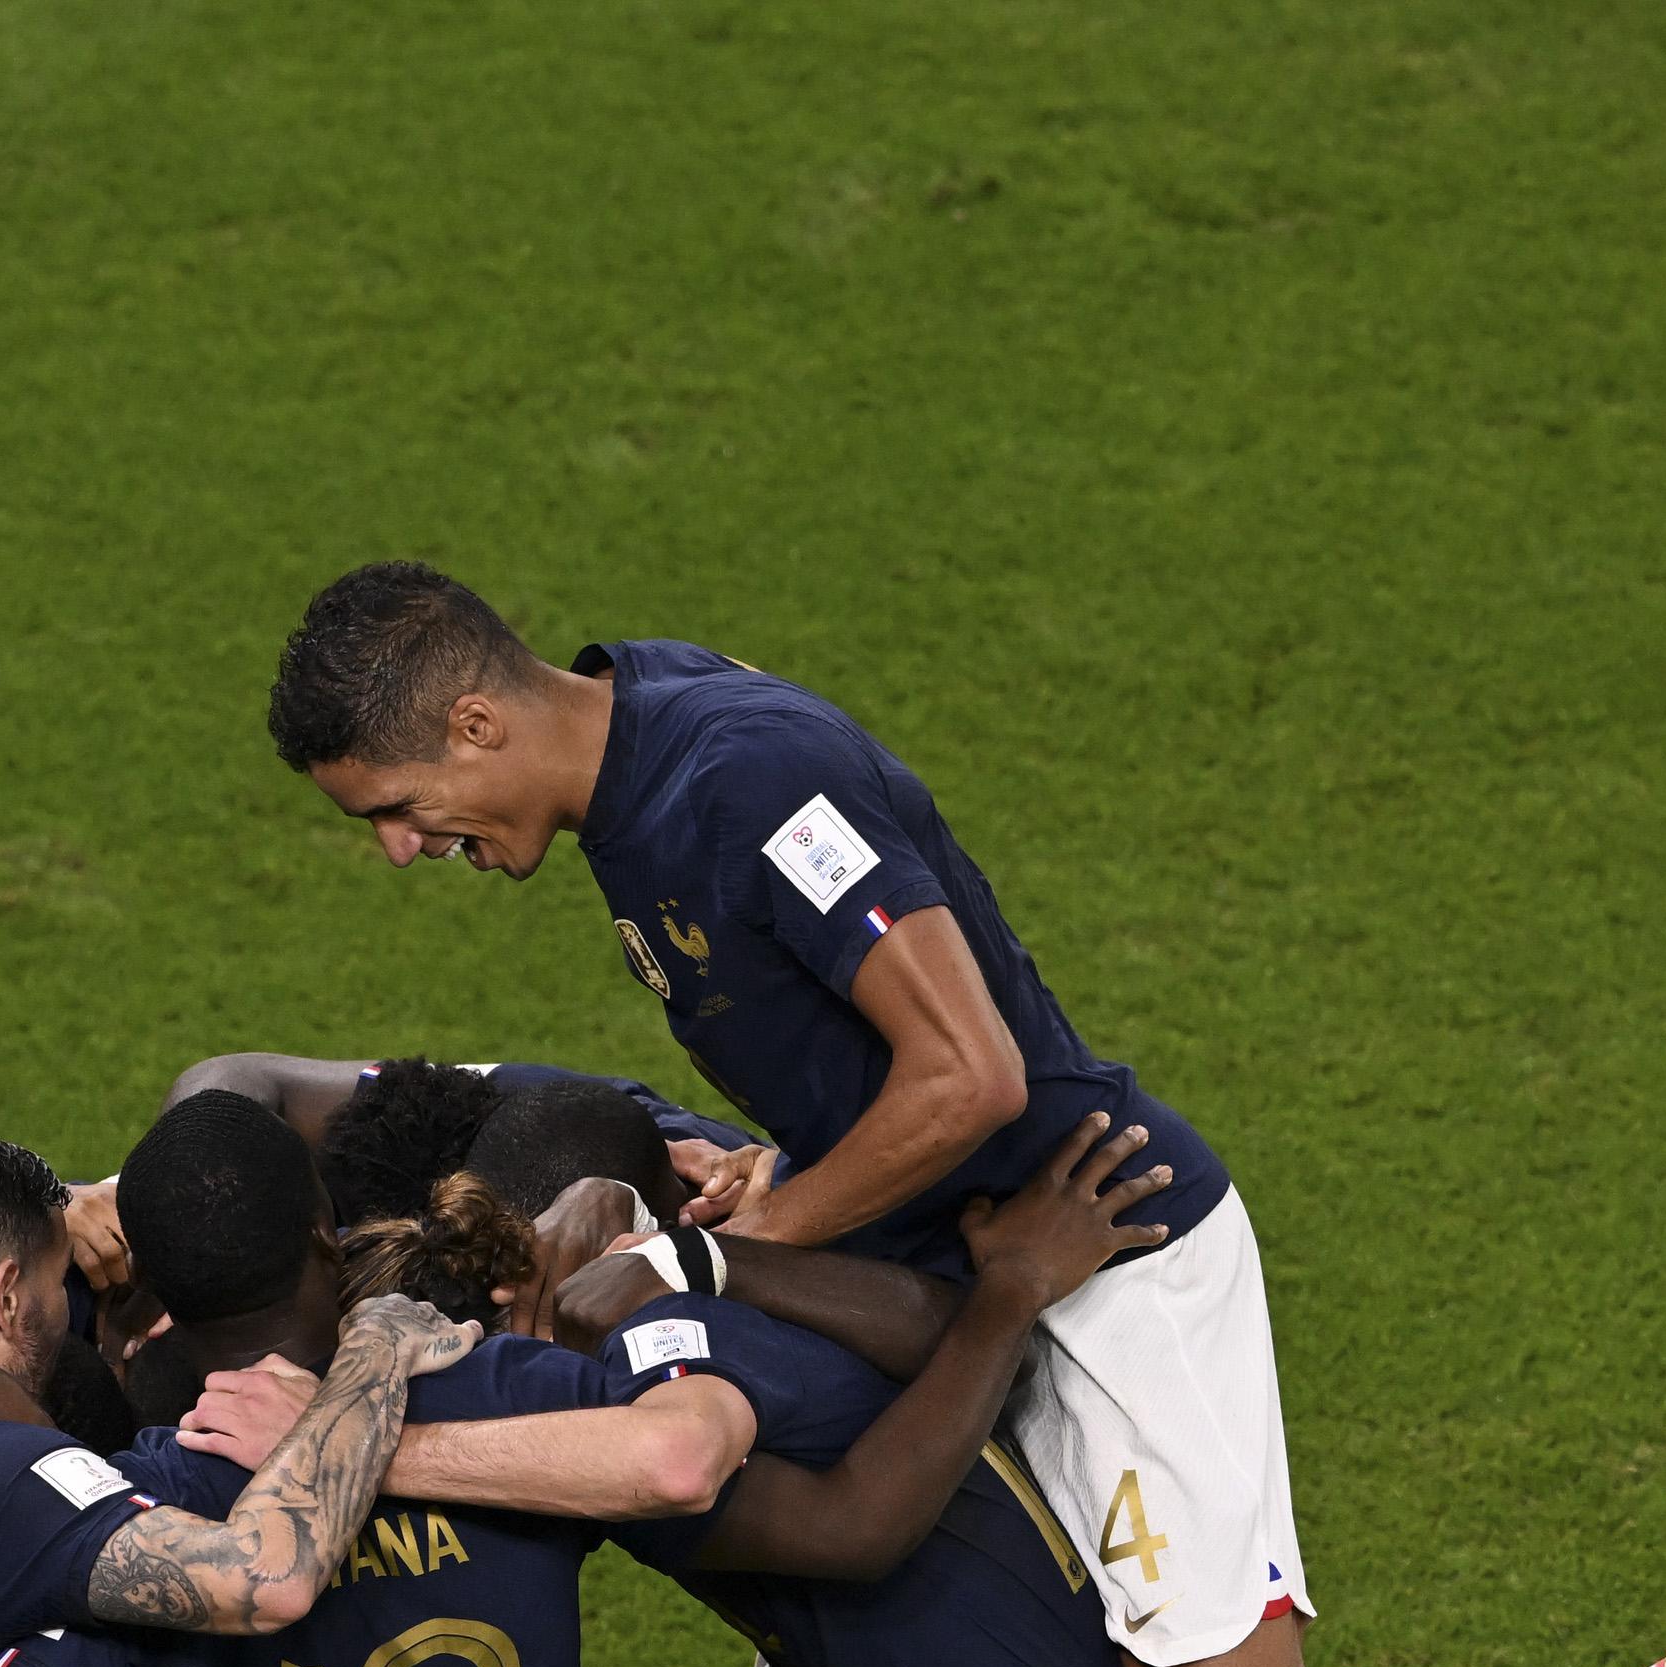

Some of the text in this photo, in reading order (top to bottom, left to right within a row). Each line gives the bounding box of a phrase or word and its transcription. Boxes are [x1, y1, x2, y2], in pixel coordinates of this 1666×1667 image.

[810, 844, 838, 872] UNITES
[331, 1507, 470, 1589] ANA
[1100, 1469, 1169, 1583] 4
